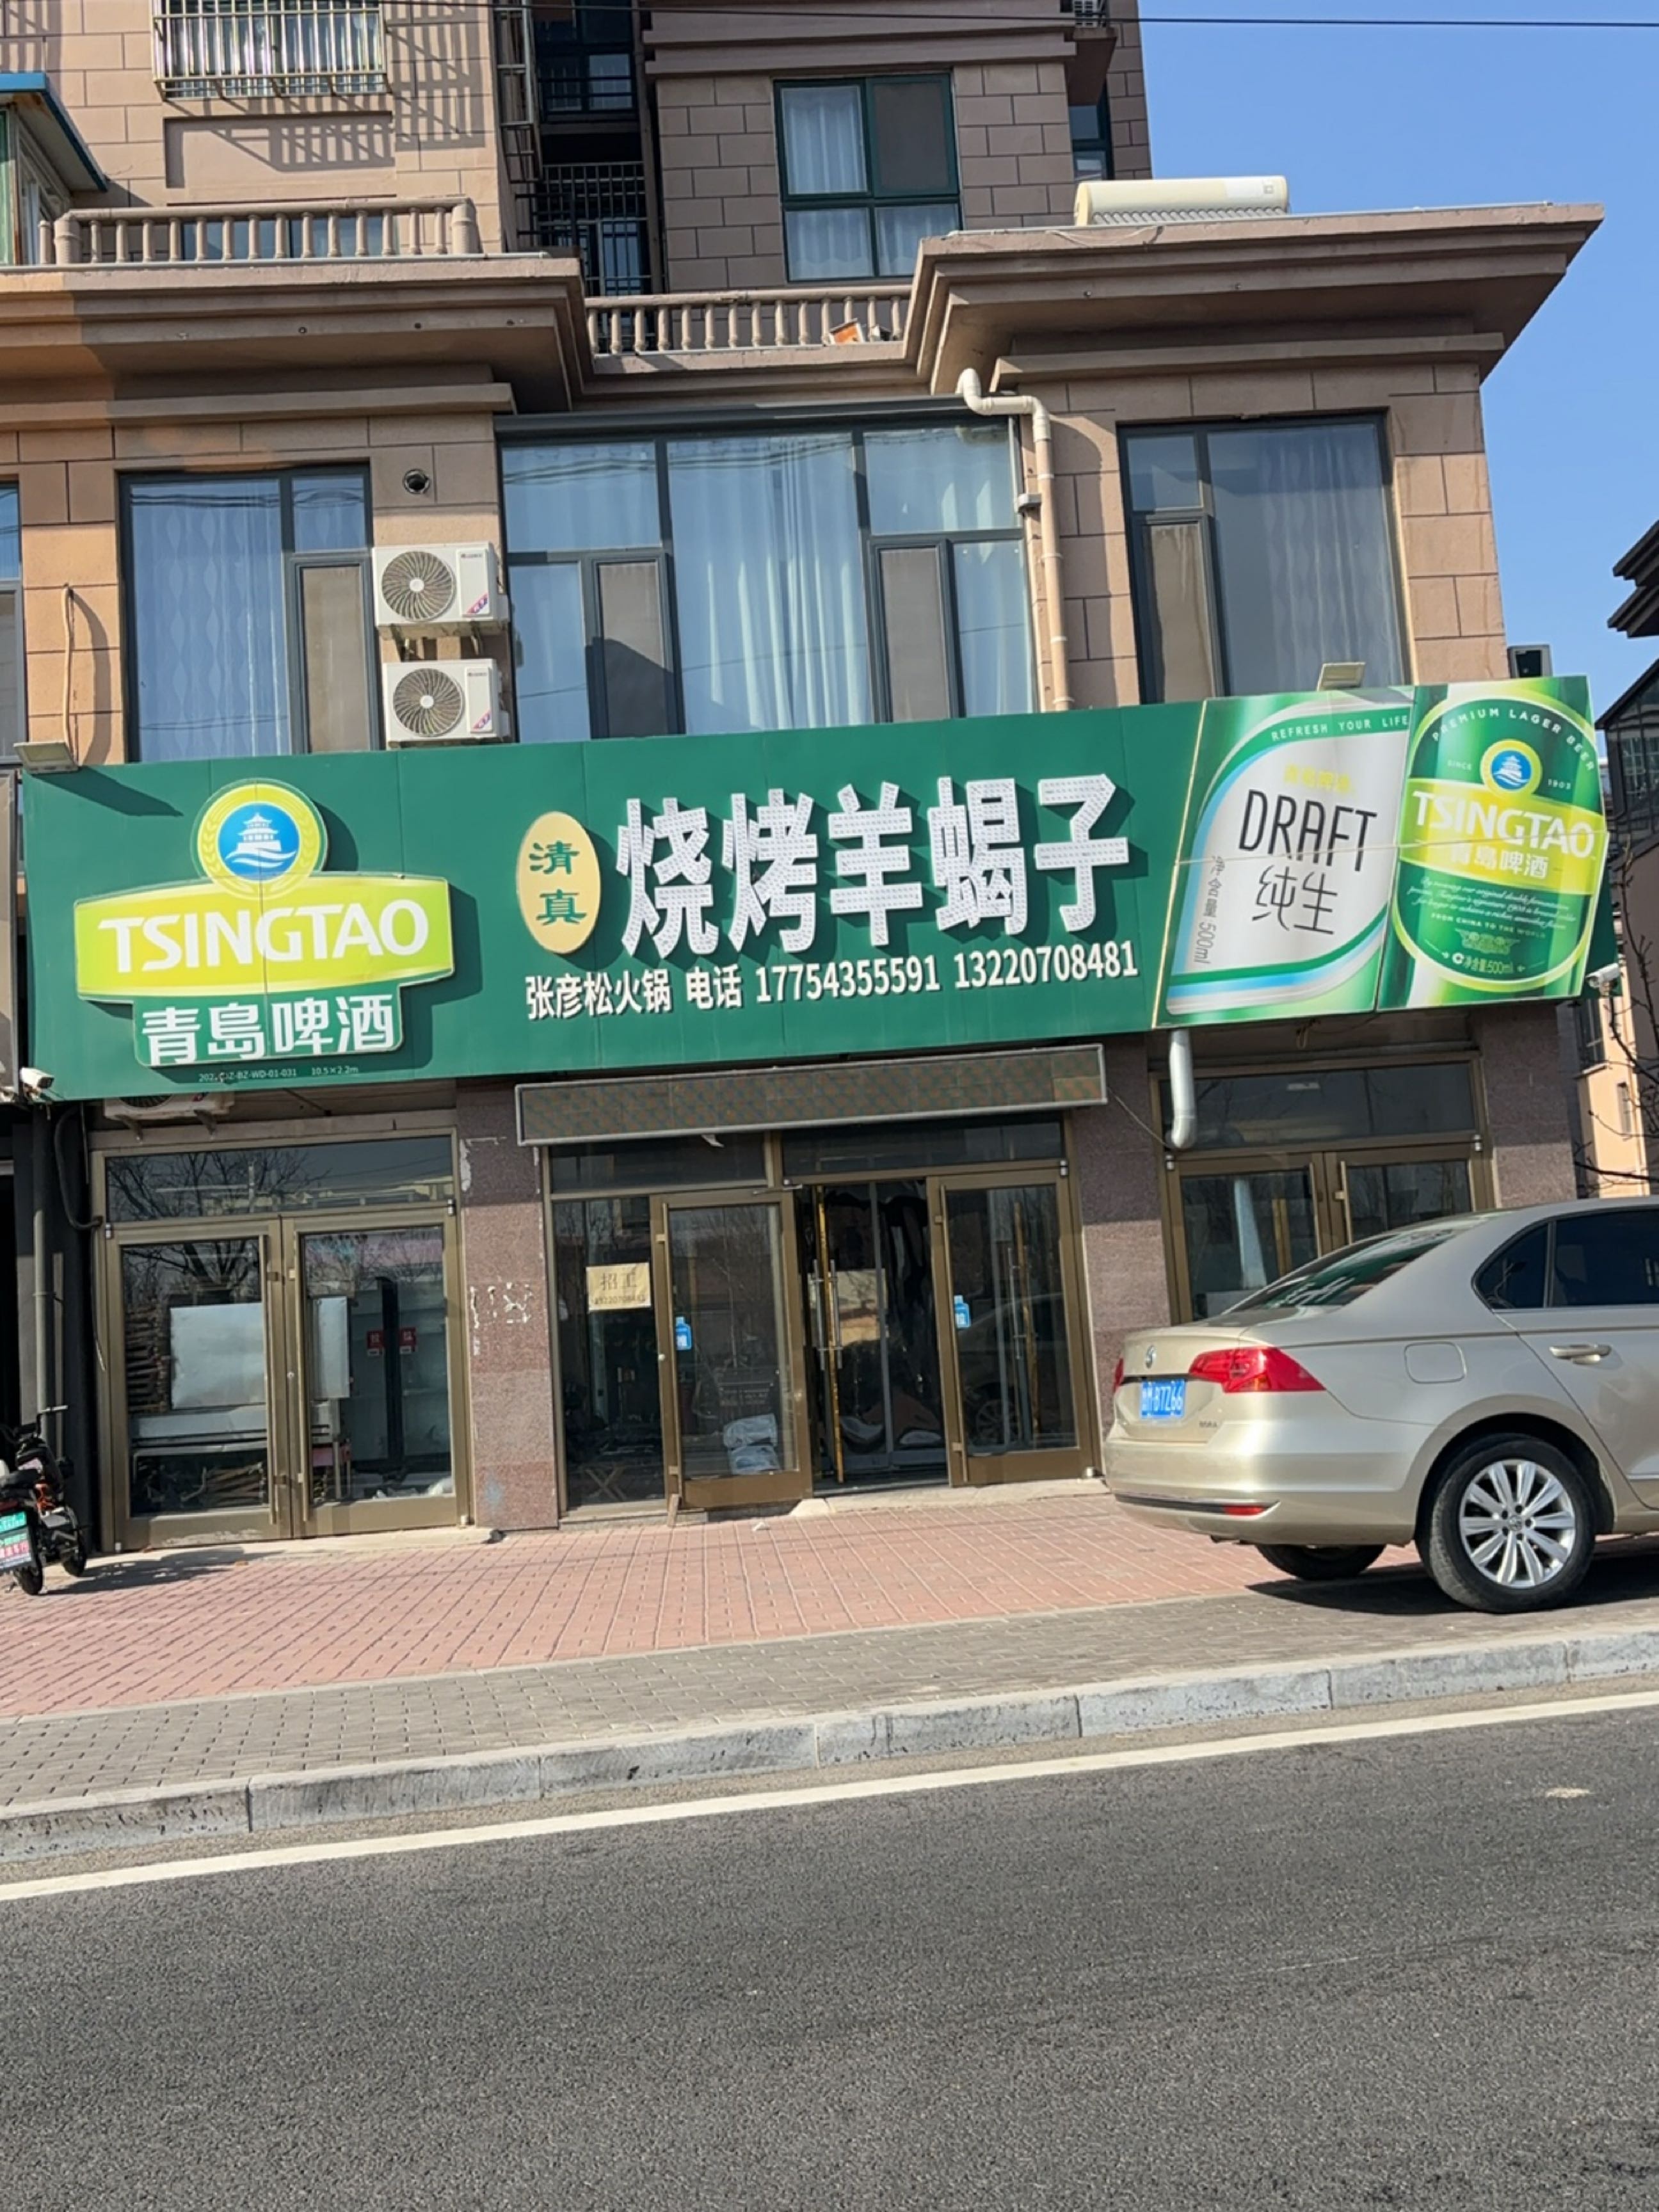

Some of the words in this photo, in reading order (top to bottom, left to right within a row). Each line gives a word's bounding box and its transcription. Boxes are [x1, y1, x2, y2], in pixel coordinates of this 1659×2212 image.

[1271, 724, 1328, 741] REFRESH
[1338, 719, 1371, 731] YOUR
[1382, 715, 1408, 728] LIFE
[1432, 708, 1499, 741] PREMIUM
[1509, 709, 1561, 733] LAGER
[1566, 735, 1594, 771] BEER
[1447, 760, 1471, 771] SINCE
[1238, 789, 1377, 872] DRAFT
[1413, 790, 1594, 858] TSINGTAO
[529, 840, 587, 926] 清真
[616, 773, 1130, 959] 烧烤羊蝎子
[1252, 865, 1338, 934] 纯生
[98, 899, 429, 973] TSINGTAO
[525, 968, 673, 1022] 张彦松火锅
[685, 964, 743, 1011] 电话
[757, 954, 941, 1004] 17754355591
[954, 940, 1139, 989] 13220708481
[141, 995, 399, 1066] 青島啤酒
